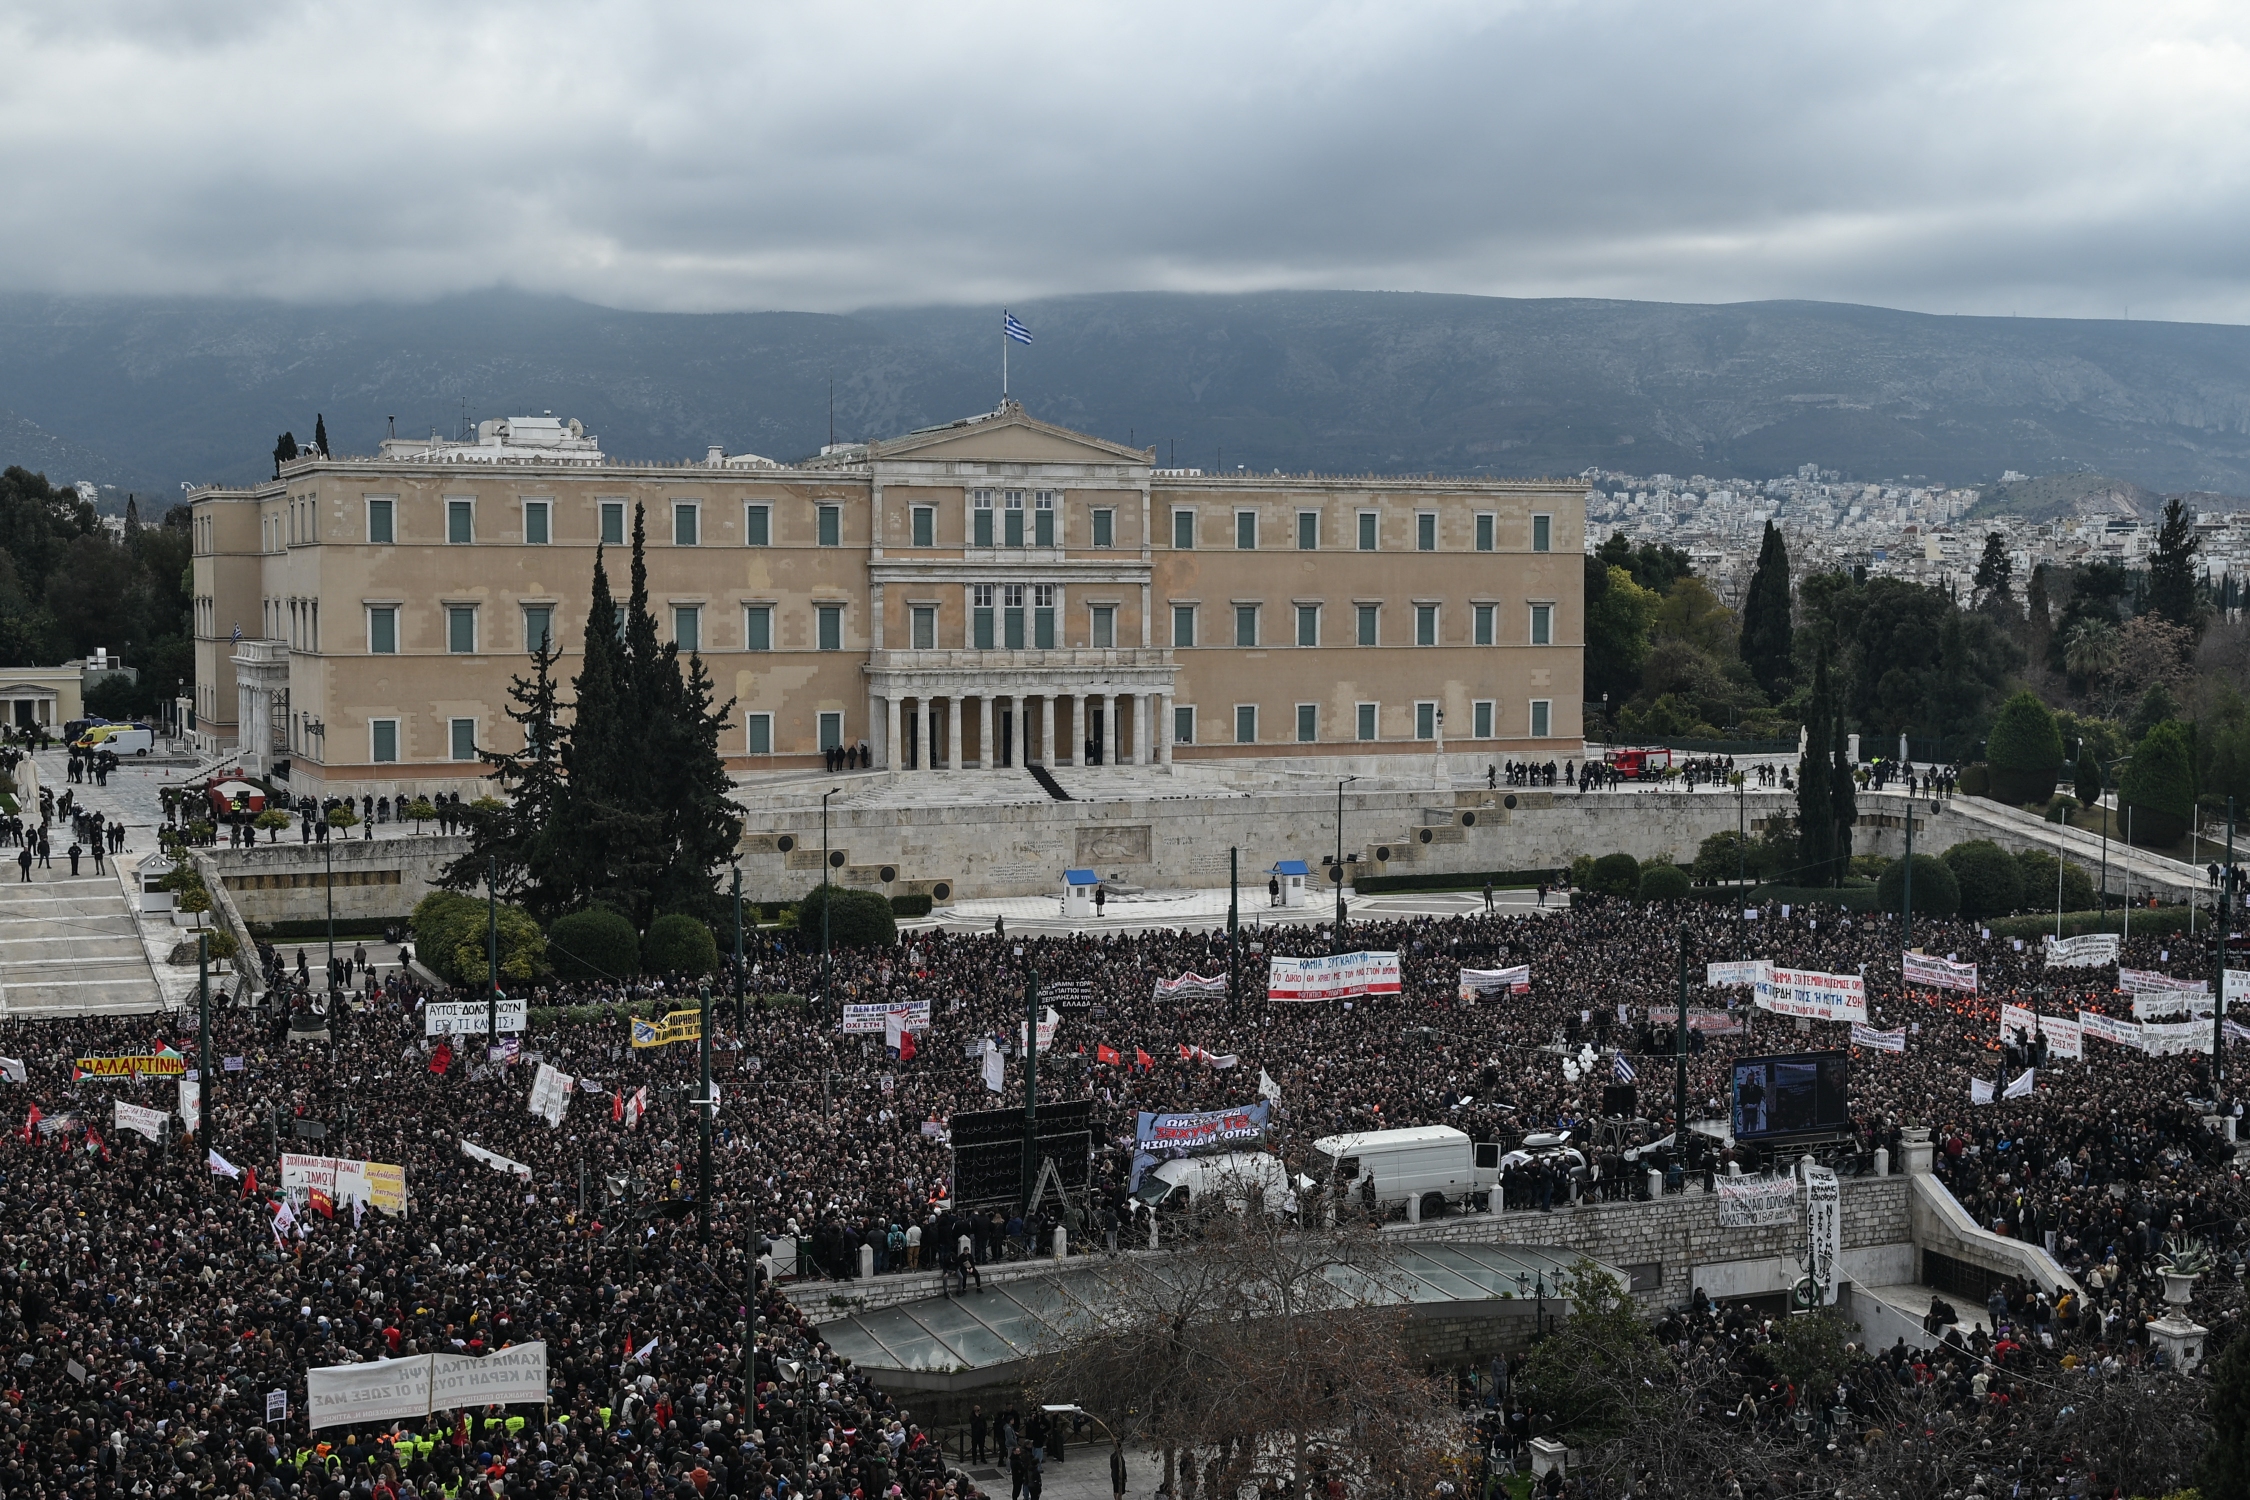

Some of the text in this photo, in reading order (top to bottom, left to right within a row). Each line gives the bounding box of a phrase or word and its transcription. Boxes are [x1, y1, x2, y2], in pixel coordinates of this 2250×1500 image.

[1300, 953, 1368, 969] ΚΑΜΙΑ ΣΥΓΚΑΛΥΨΗ
[1273, 973, 1281, 981] ΤΟ
[1334, 972, 1341, 980] ΜΕ
[1366, 967, 1379, 975] ΣΤΟΝ
[1773, 987, 1791, 999] ΡΔΗ
[1795, 990, 1811, 1002] ΤΟΥΣ
[1831, 995, 1842, 1006] ΤΗ
[429, 1002, 521, 1016] ΑΥΤΟΙ ΔΟΛΟΦΝΟΥΝ
[853, 1005, 869, 1013] ΔΕΝ
[457, 1019, 470, 1030] ΤΙ
[474, 1016, 514, 1030] ΚΑΝΙΣ;
[1720, 1200, 1729, 1213] ΤΟ
[1720, 1211, 1757, 1226] ΔΙΚΑΣΤΗΡΙΟ
